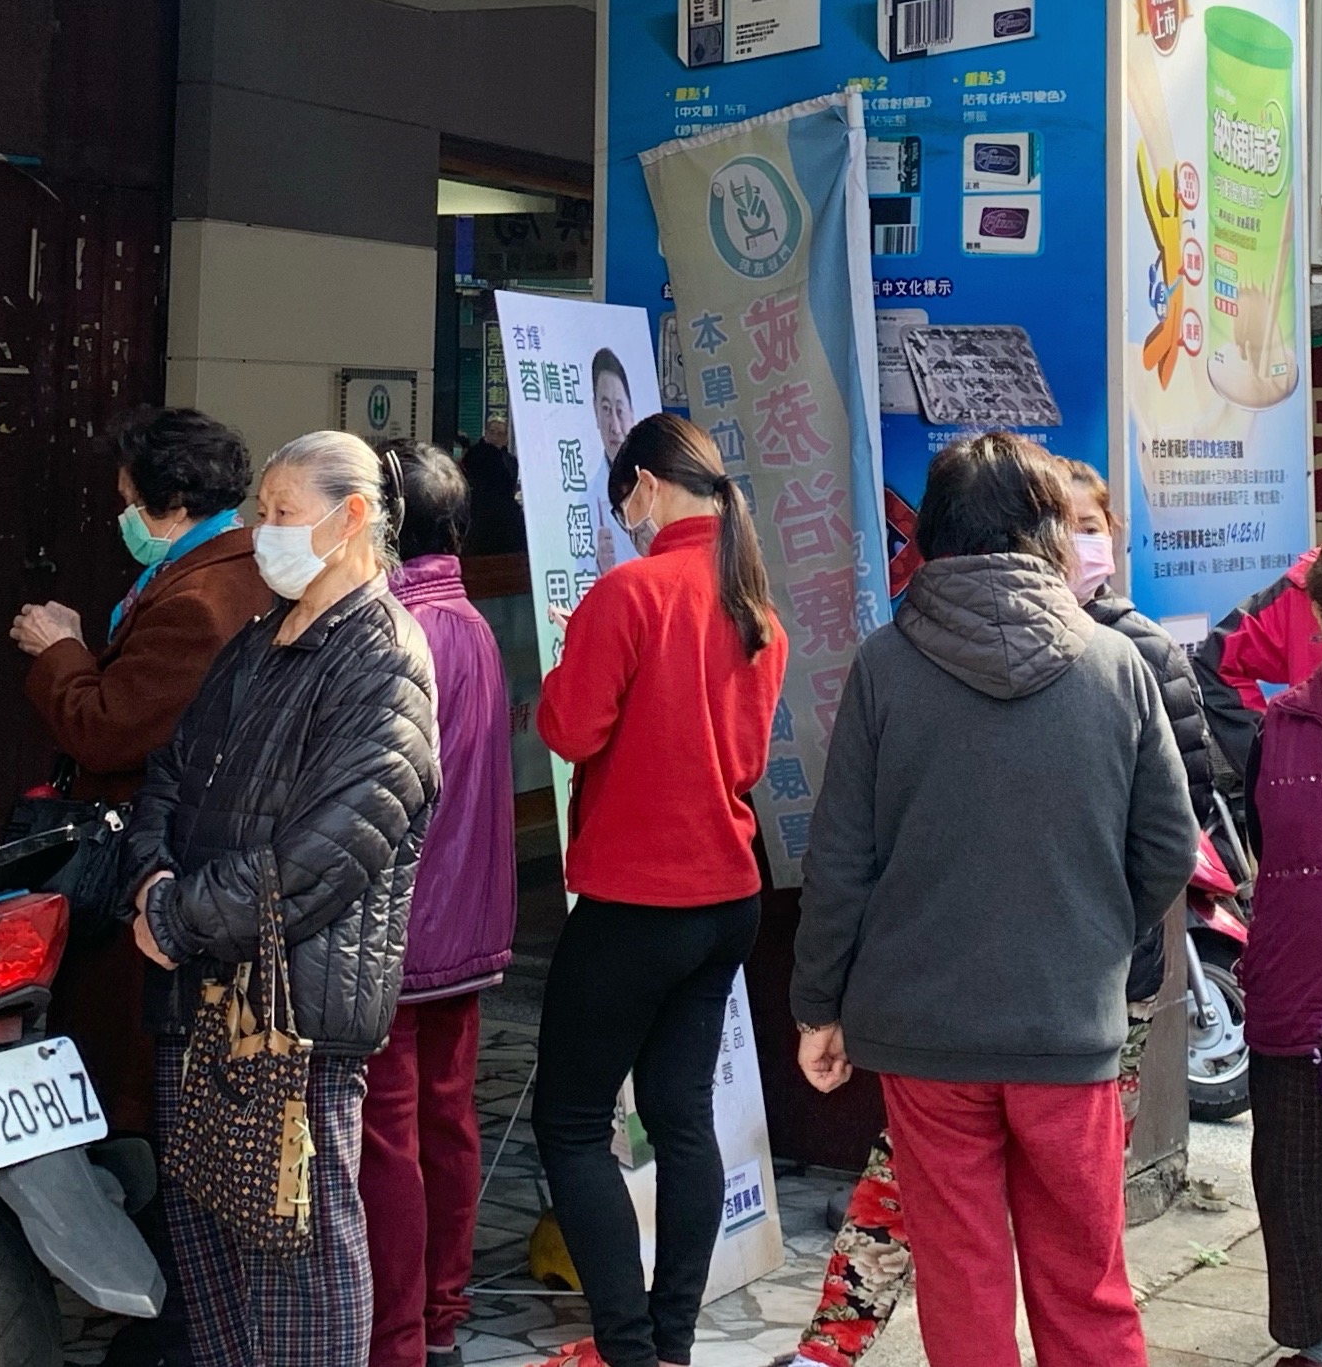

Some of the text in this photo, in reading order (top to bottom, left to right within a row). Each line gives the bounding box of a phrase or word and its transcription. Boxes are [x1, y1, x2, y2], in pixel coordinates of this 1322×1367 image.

[1154, 6, 1177, 41] 上市
[1213, 107, 1283, 177] 納補瑞多
[511, 324, 542, 352] 杏輝
[519, 359, 584, 405] 蓉憶記
